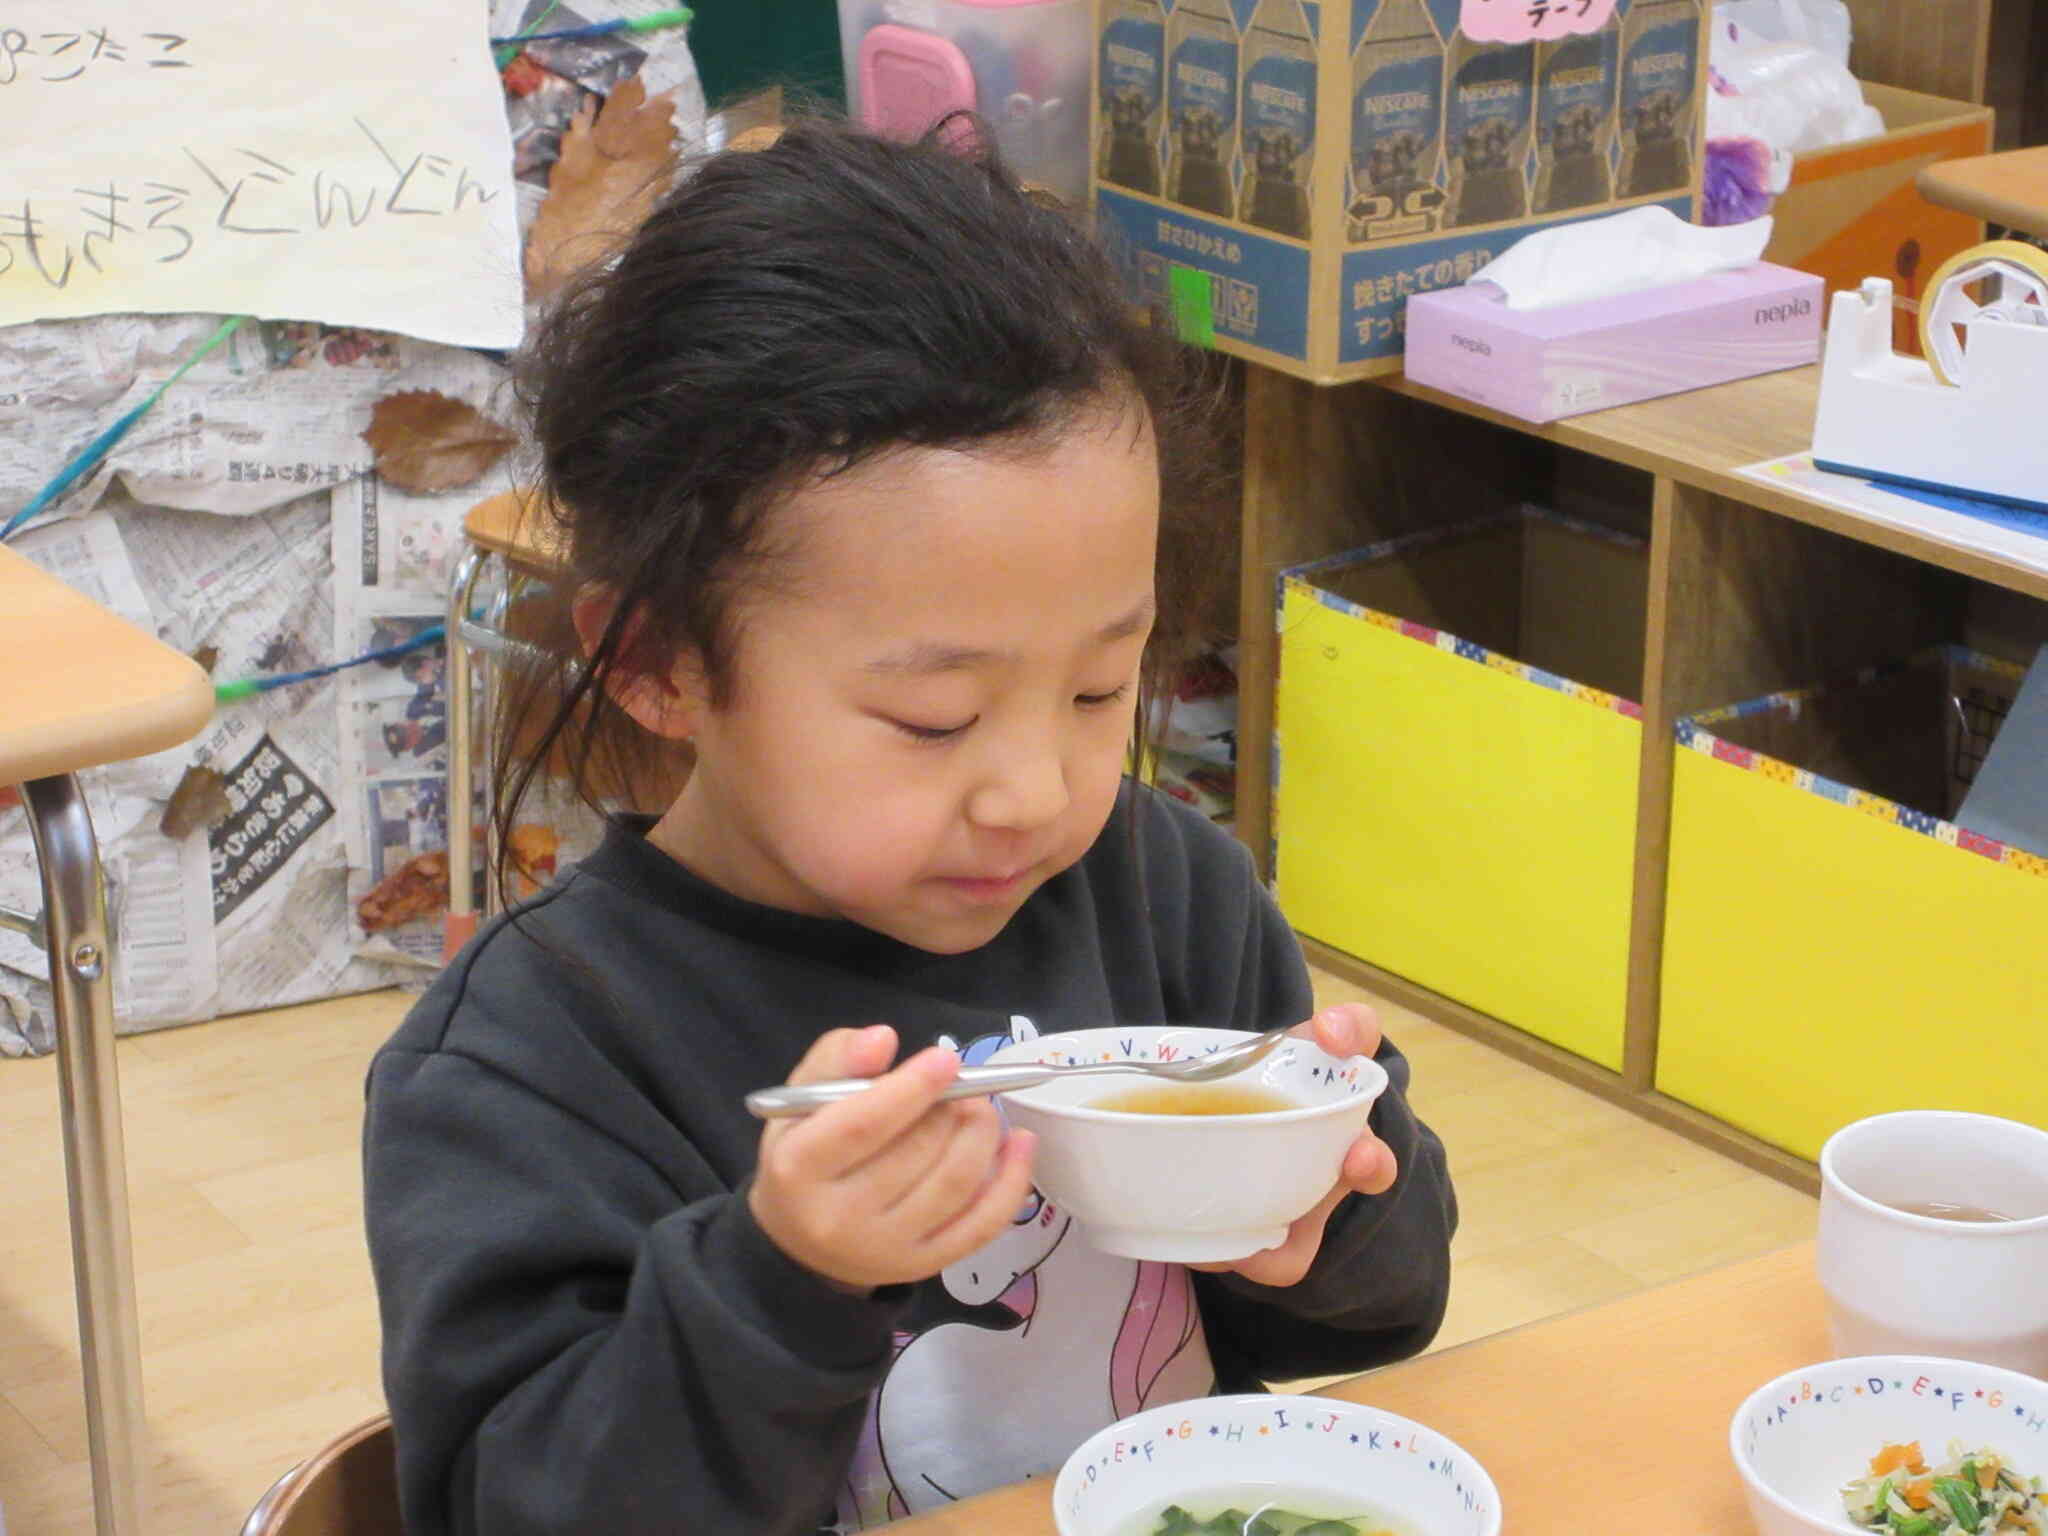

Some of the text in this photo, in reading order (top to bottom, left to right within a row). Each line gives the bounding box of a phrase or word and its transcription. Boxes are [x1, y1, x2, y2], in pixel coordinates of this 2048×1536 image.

[1755, 297, 1811, 325] nepia
[1119, 1038, 1133, 1056] V
[1157, 1043, 1179, 1061] W
[1323, 1066, 1335, 1085] A
[1776, 1404, 1788, 1424] A
[1801, 1381, 1812, 1400] B
[1868, 1377, 1884, 1394] D
[1911, 1375, 1931, 1396] E
[1951, 1391, 1964, 1411] F
[1114, 1441, 1125, 1462] E
[1143, 1439, 1155, 1462] F
[1178, 1420, 1193, 1440] G
[1225, 1423, 1245, 1443] H
[1274, 1409, 1290, 1429] I
[1322, 1414, 1341, 1432] J
[1368, 1431, 1383, 1449] K
[1407, 1433, 1419, 1453] L
